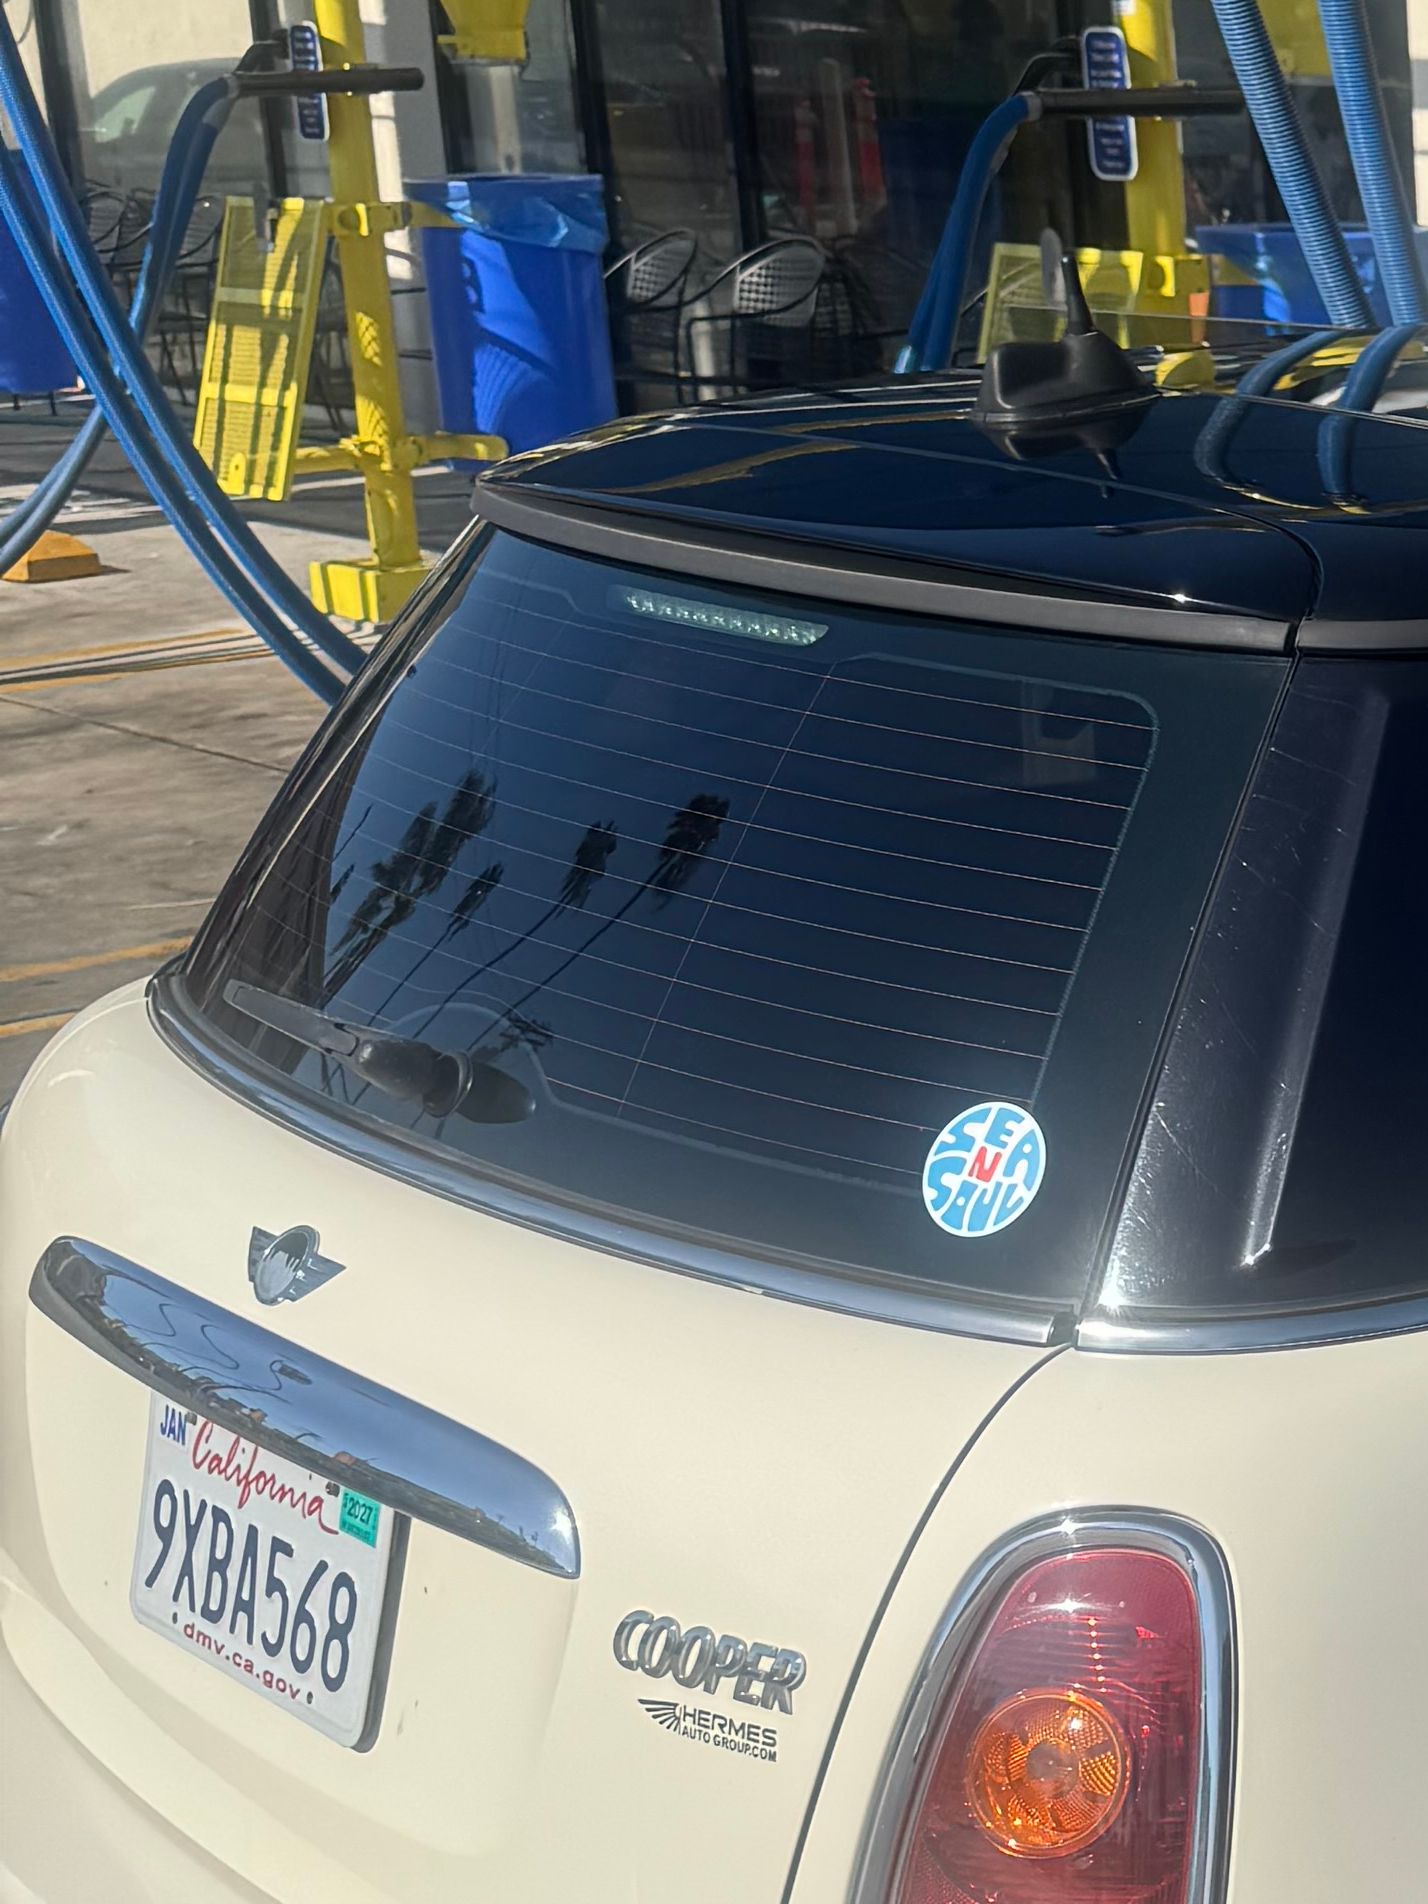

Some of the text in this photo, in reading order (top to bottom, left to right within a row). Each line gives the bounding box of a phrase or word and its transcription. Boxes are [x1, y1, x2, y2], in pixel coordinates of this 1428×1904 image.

[934, 1106, 1041, 1192] SEA
[968, 1146, 1002, 1183] N
[927, 1156, 1025, 1232] SOUL
[160, 1404, 187, 1445] JAN
[191, 1419, 339, 1535] California
[347, 1497, 373, 1526] 2027
[144, 1478, 357, 1692] 9XBA568
[183, 1622, 301, 1699] dmv.ca.gov
[613, 1609, 807, 1715] COOPER
[681, 1725, 778, 1763] AUTO GROUP.COM
[682, 1705, 778, 1748] HERMES
